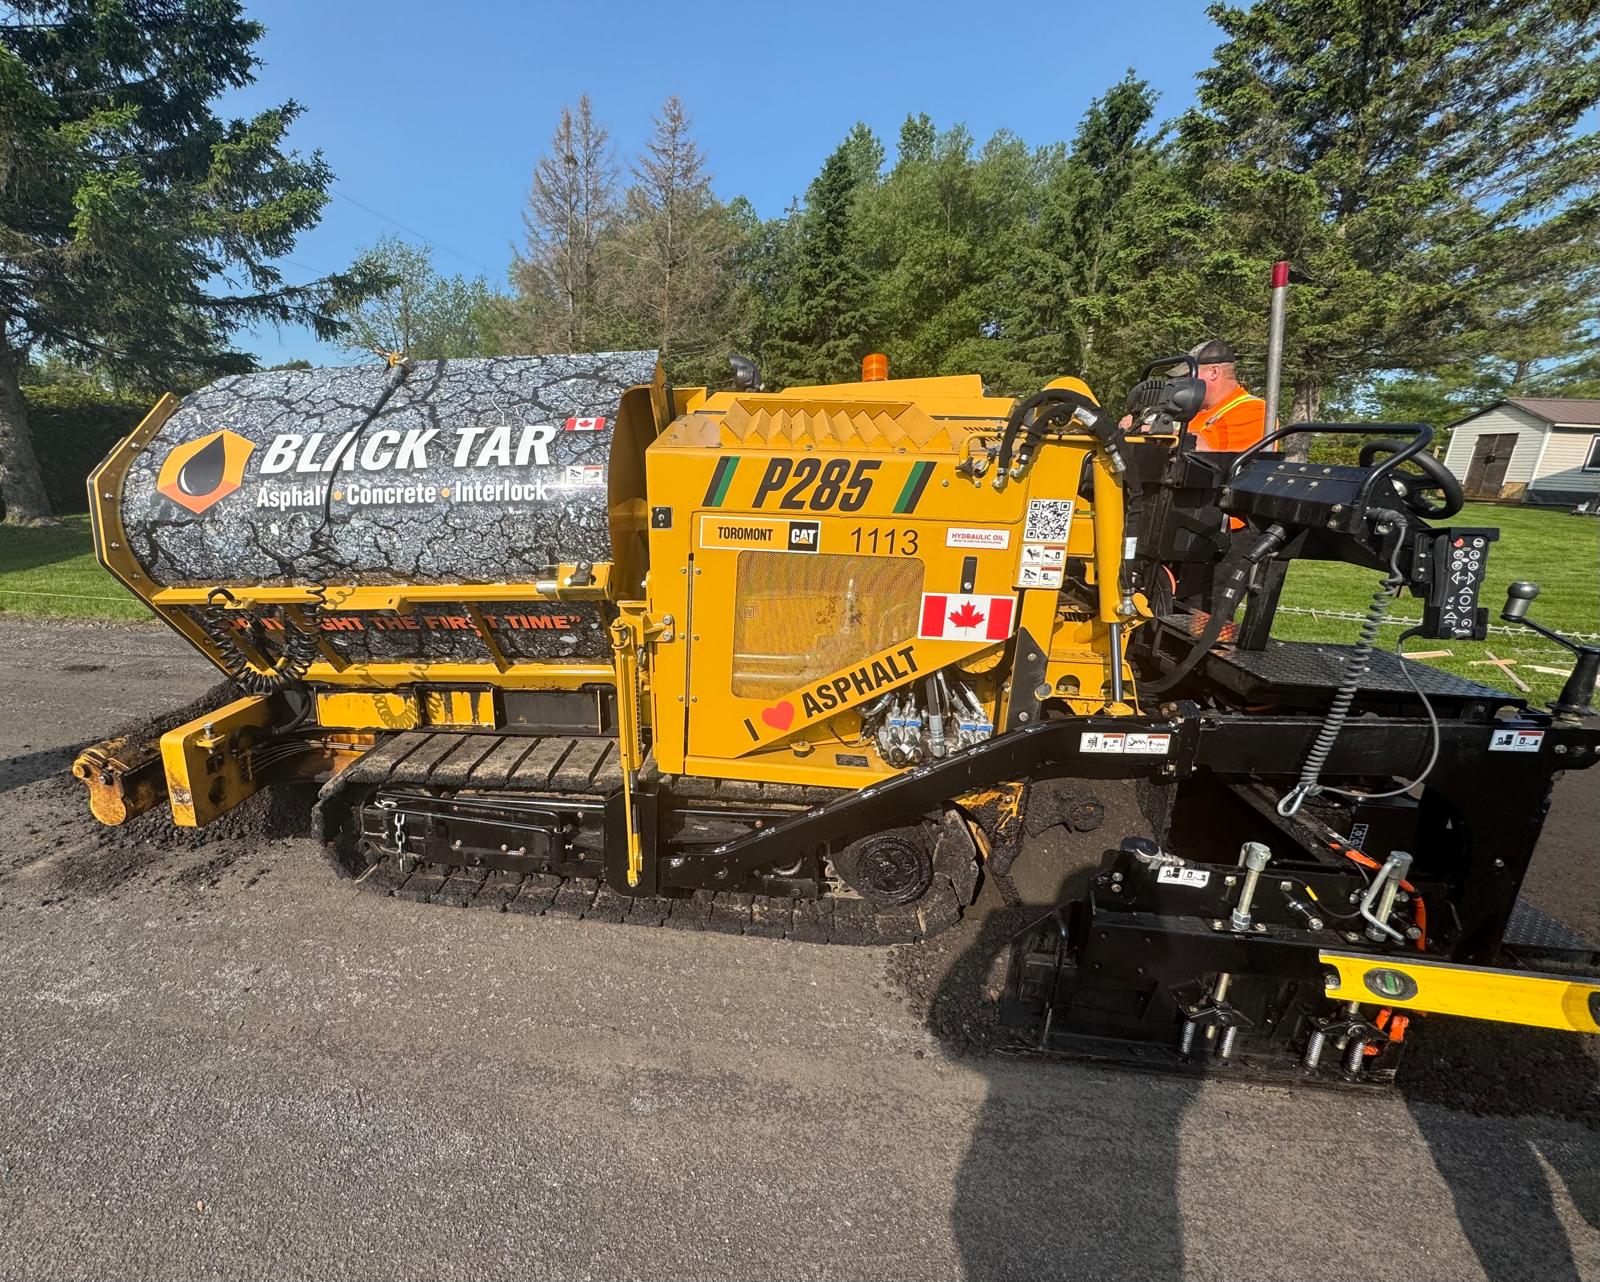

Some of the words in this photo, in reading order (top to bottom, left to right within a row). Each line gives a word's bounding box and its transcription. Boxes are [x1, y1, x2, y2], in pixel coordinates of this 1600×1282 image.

[259, 429, 441, 474] BLACK
[453, 425, 557, 468] TAR
[346, 484, 437, 505] Concrete
[455, 479, 549, 502] Interlock
[752, 458, 883, 512] P285
[717, 526, 774, 541] TOROMONT
[791, 528, 816, 545] CAT
[850, 526, 919, 556] 1113
[951, 532, 991, 541] HYDRAULIC
[992, 534, 1005, 542] OIL
[369, 615, 421, 630] THE
[743, 718, 760, 742] I
[801, 646, 919, 718] ASPHALT
